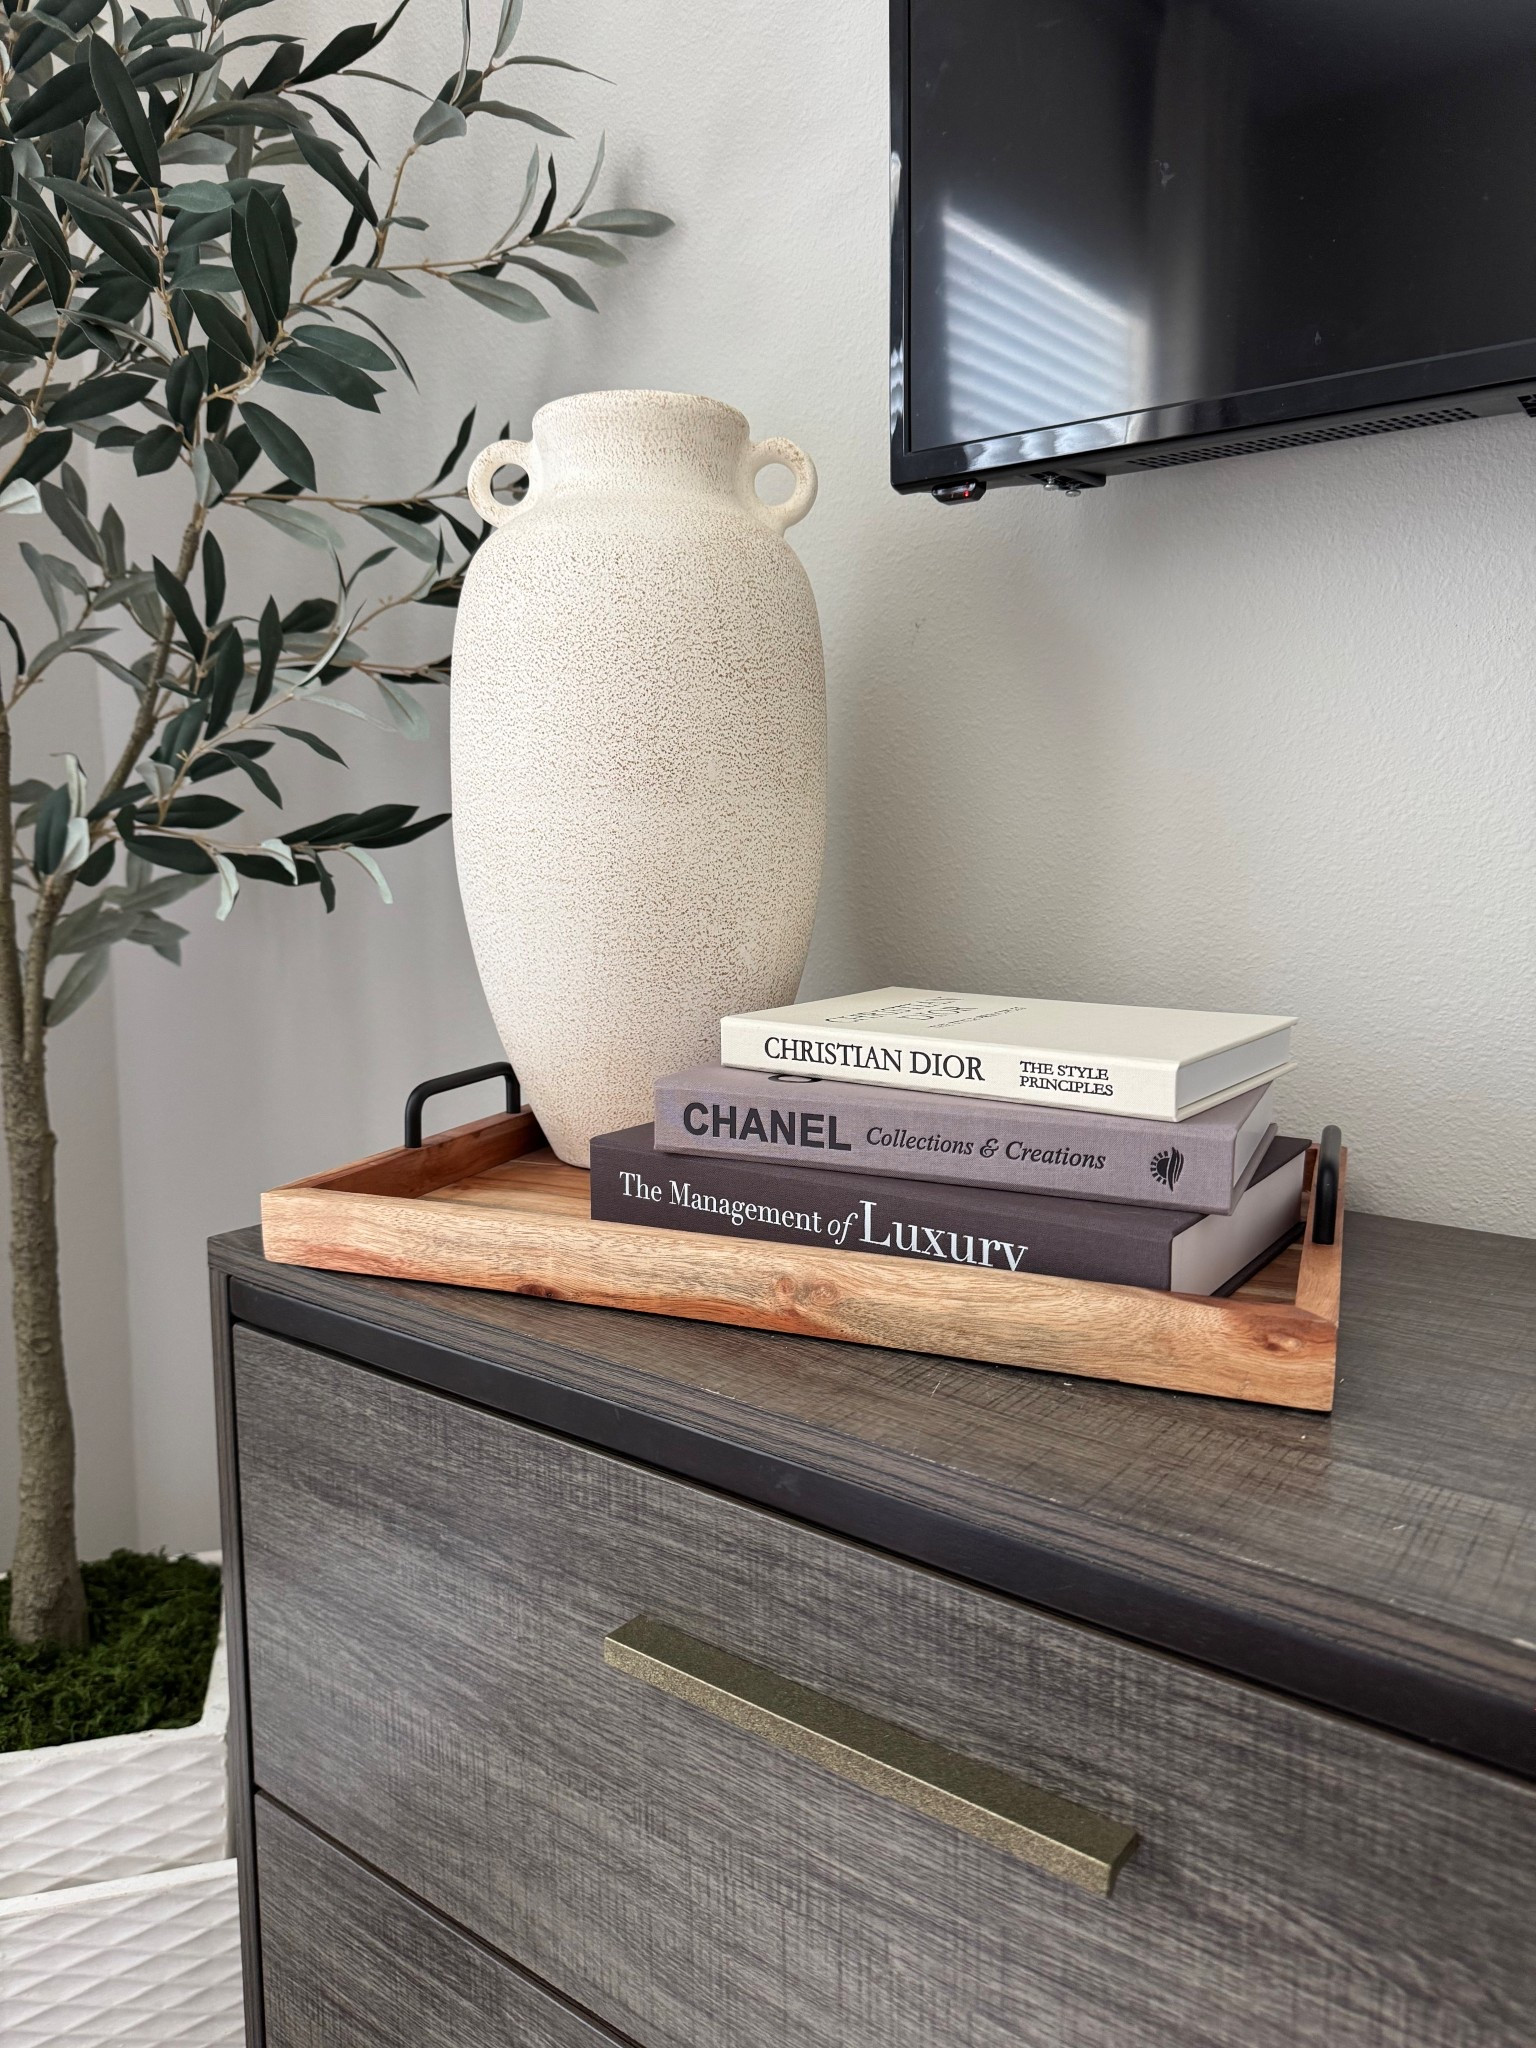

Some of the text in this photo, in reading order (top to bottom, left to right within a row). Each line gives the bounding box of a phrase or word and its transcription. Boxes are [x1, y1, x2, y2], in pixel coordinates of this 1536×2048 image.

[764, 1036, 986, 1081] CHRISTIAN DIOR
[1019, 1060, 1109, 1080] THE STYLE
[1019, 1075, 1114, 1096] PRINCIPLES
[683, 1102, 852, 1151] CHANEL
[866, 1126, 1107, 1169] Collections & Creations
[619, 1171, 662, 1202] The
[668, 1180, 823, 1233] Management
[827, 1212, 859, 1245] of
